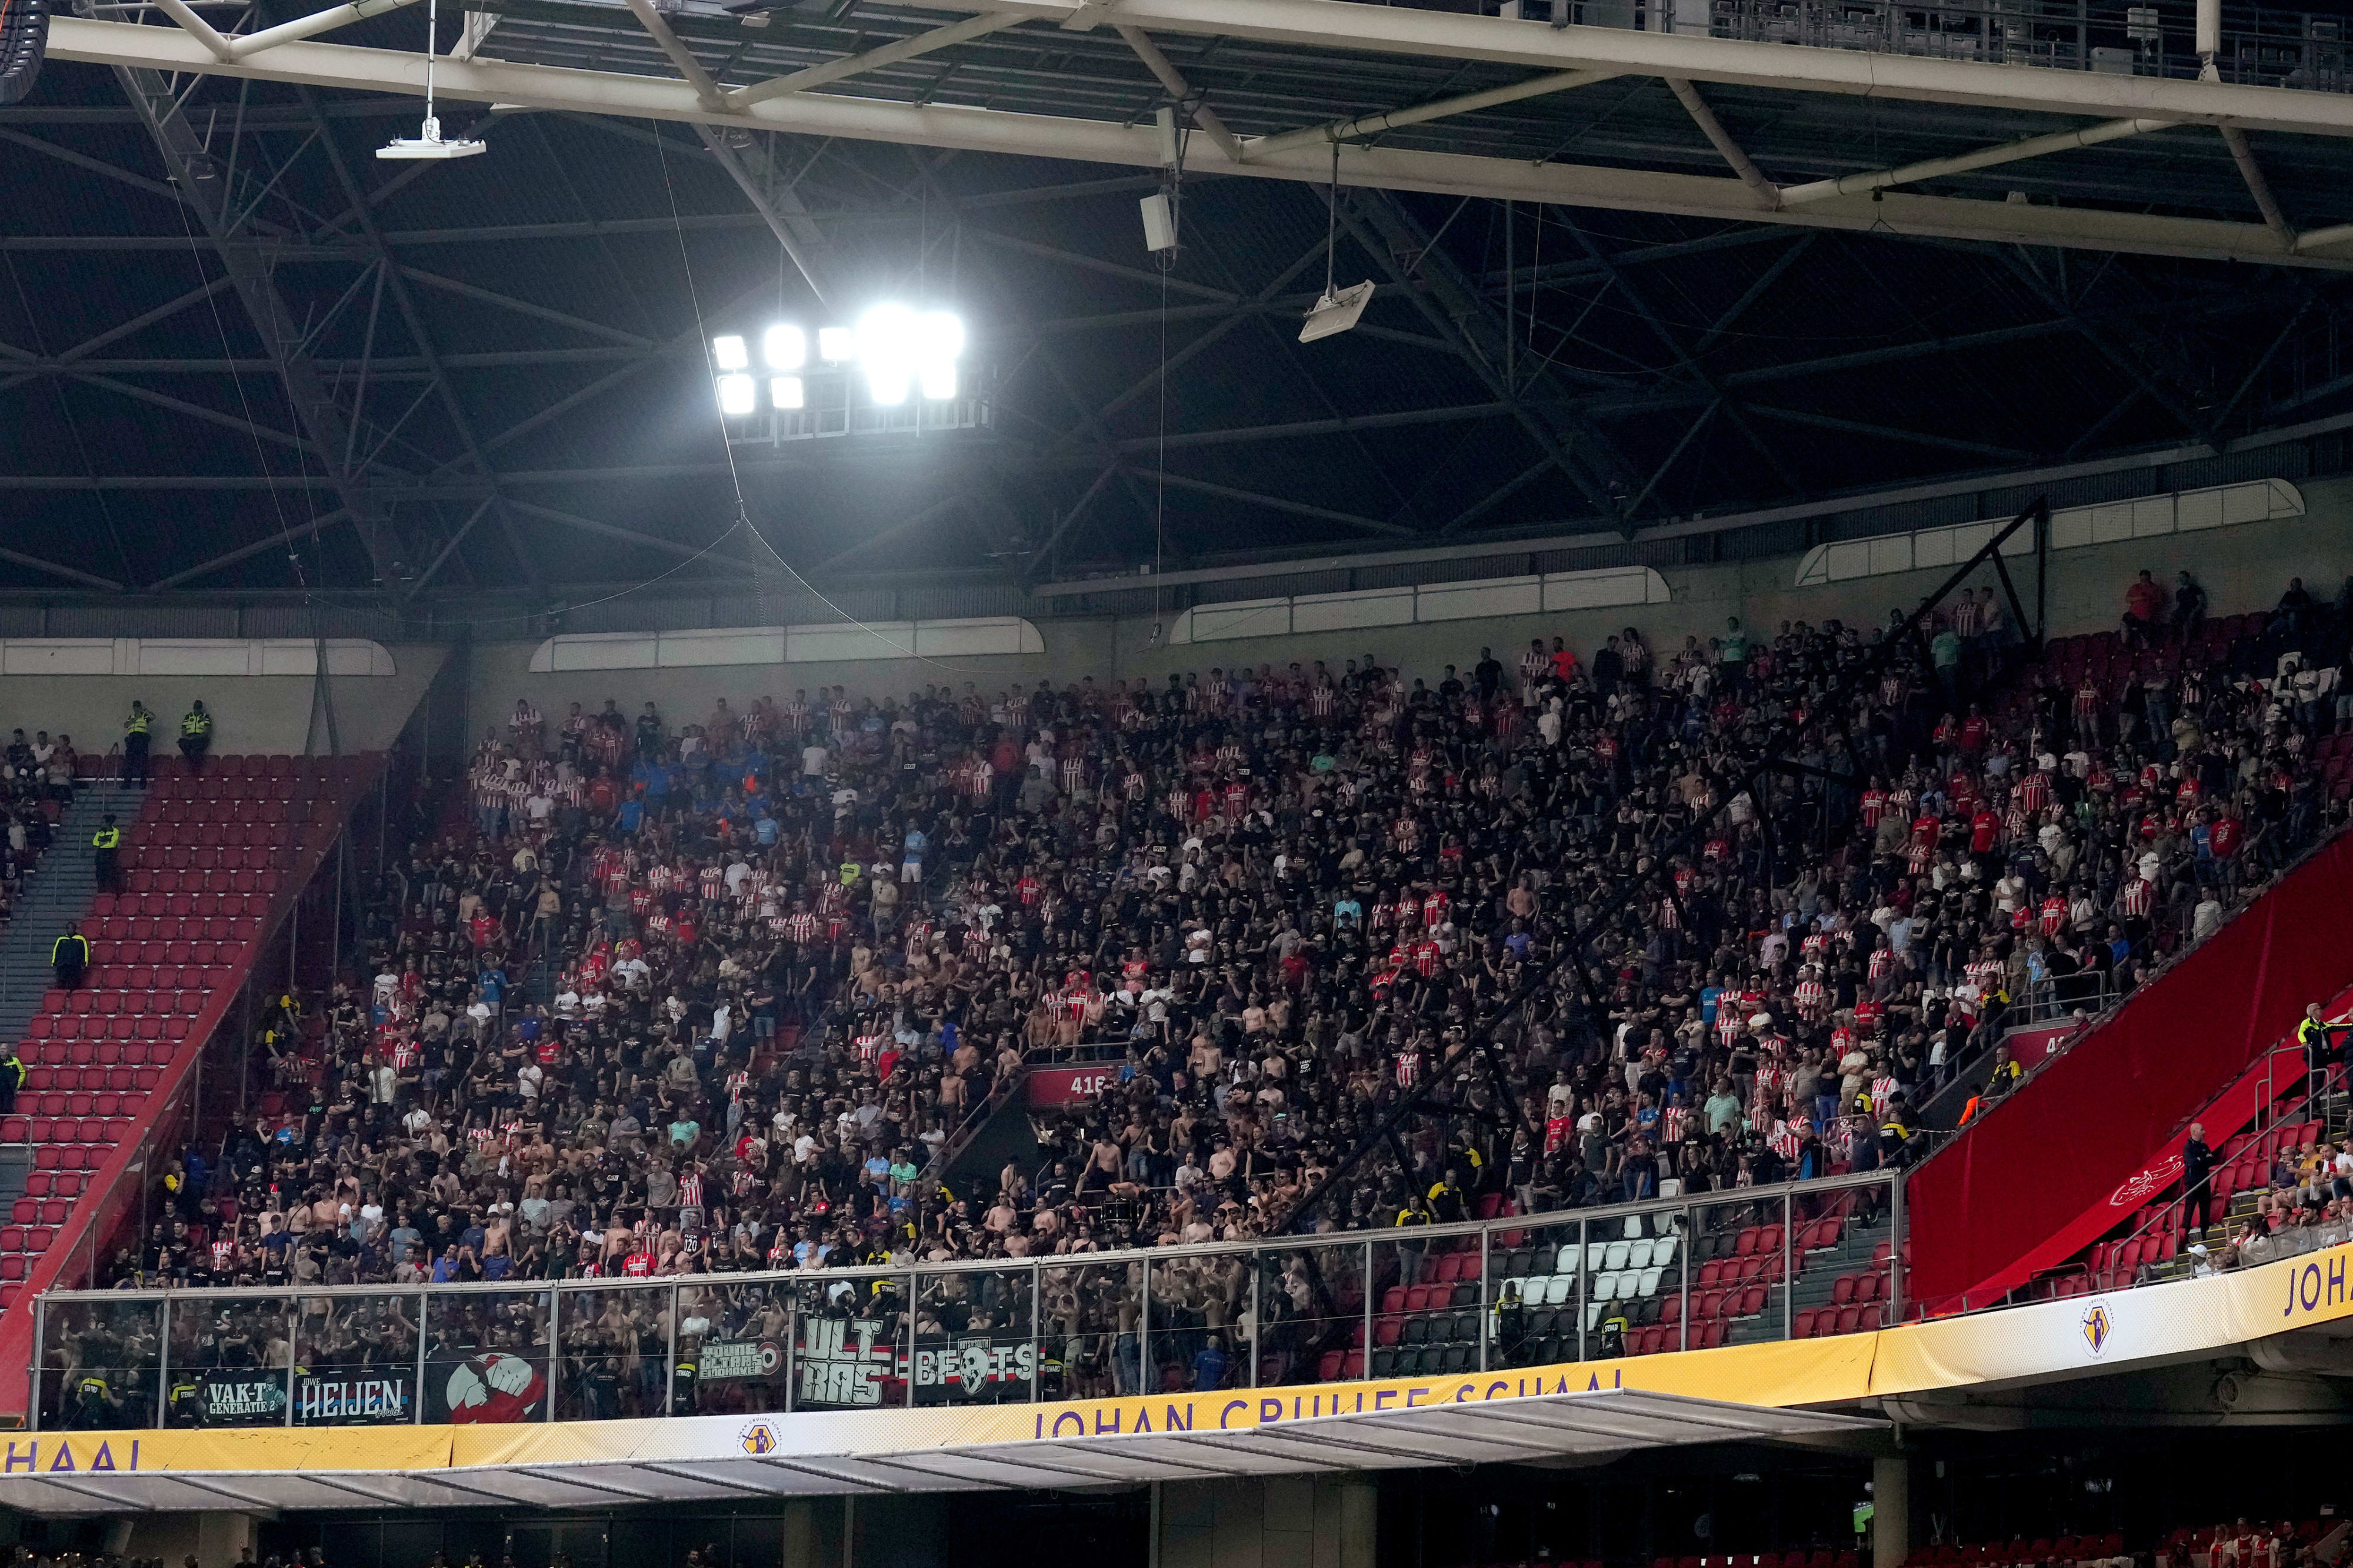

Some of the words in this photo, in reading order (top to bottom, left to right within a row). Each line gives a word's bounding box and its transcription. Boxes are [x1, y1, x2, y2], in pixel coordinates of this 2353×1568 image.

[684, 1238, 698, 1252] 020
[2284, 1255, 2353, 1317] JOH
[2095, 1320, 2101, 1330] 14
[805, 1316, 883, 1363] ULT
[959, 1340, 971, 1350] BOYS
[702, 1343, 757, 1359] YOUNG
[699, 1354, 763, 1370] ULTRAS
[1045, 1365, 1060, 1373] TEWARD
[699, 1366, 763, 1379] EINDHOVEN
[302, 1378, 321, 1386] JOWE
[800, 1360, 882, 1405] RAS
[209, 1382, 266, 1403] VAK-T
[301, 1379, 403, 1418] HEIJEN
[209, 1401, 267, 1414] GENERATIE
[270, 1400, 276, 1411] 2
[375, 1406, 404, 1419] #VWGL
[736, 1424, 748, 1442] JOHAN
[771, 1421, 783, 1441] SCHAAL
[758, 1436, 765, 1444] 14
